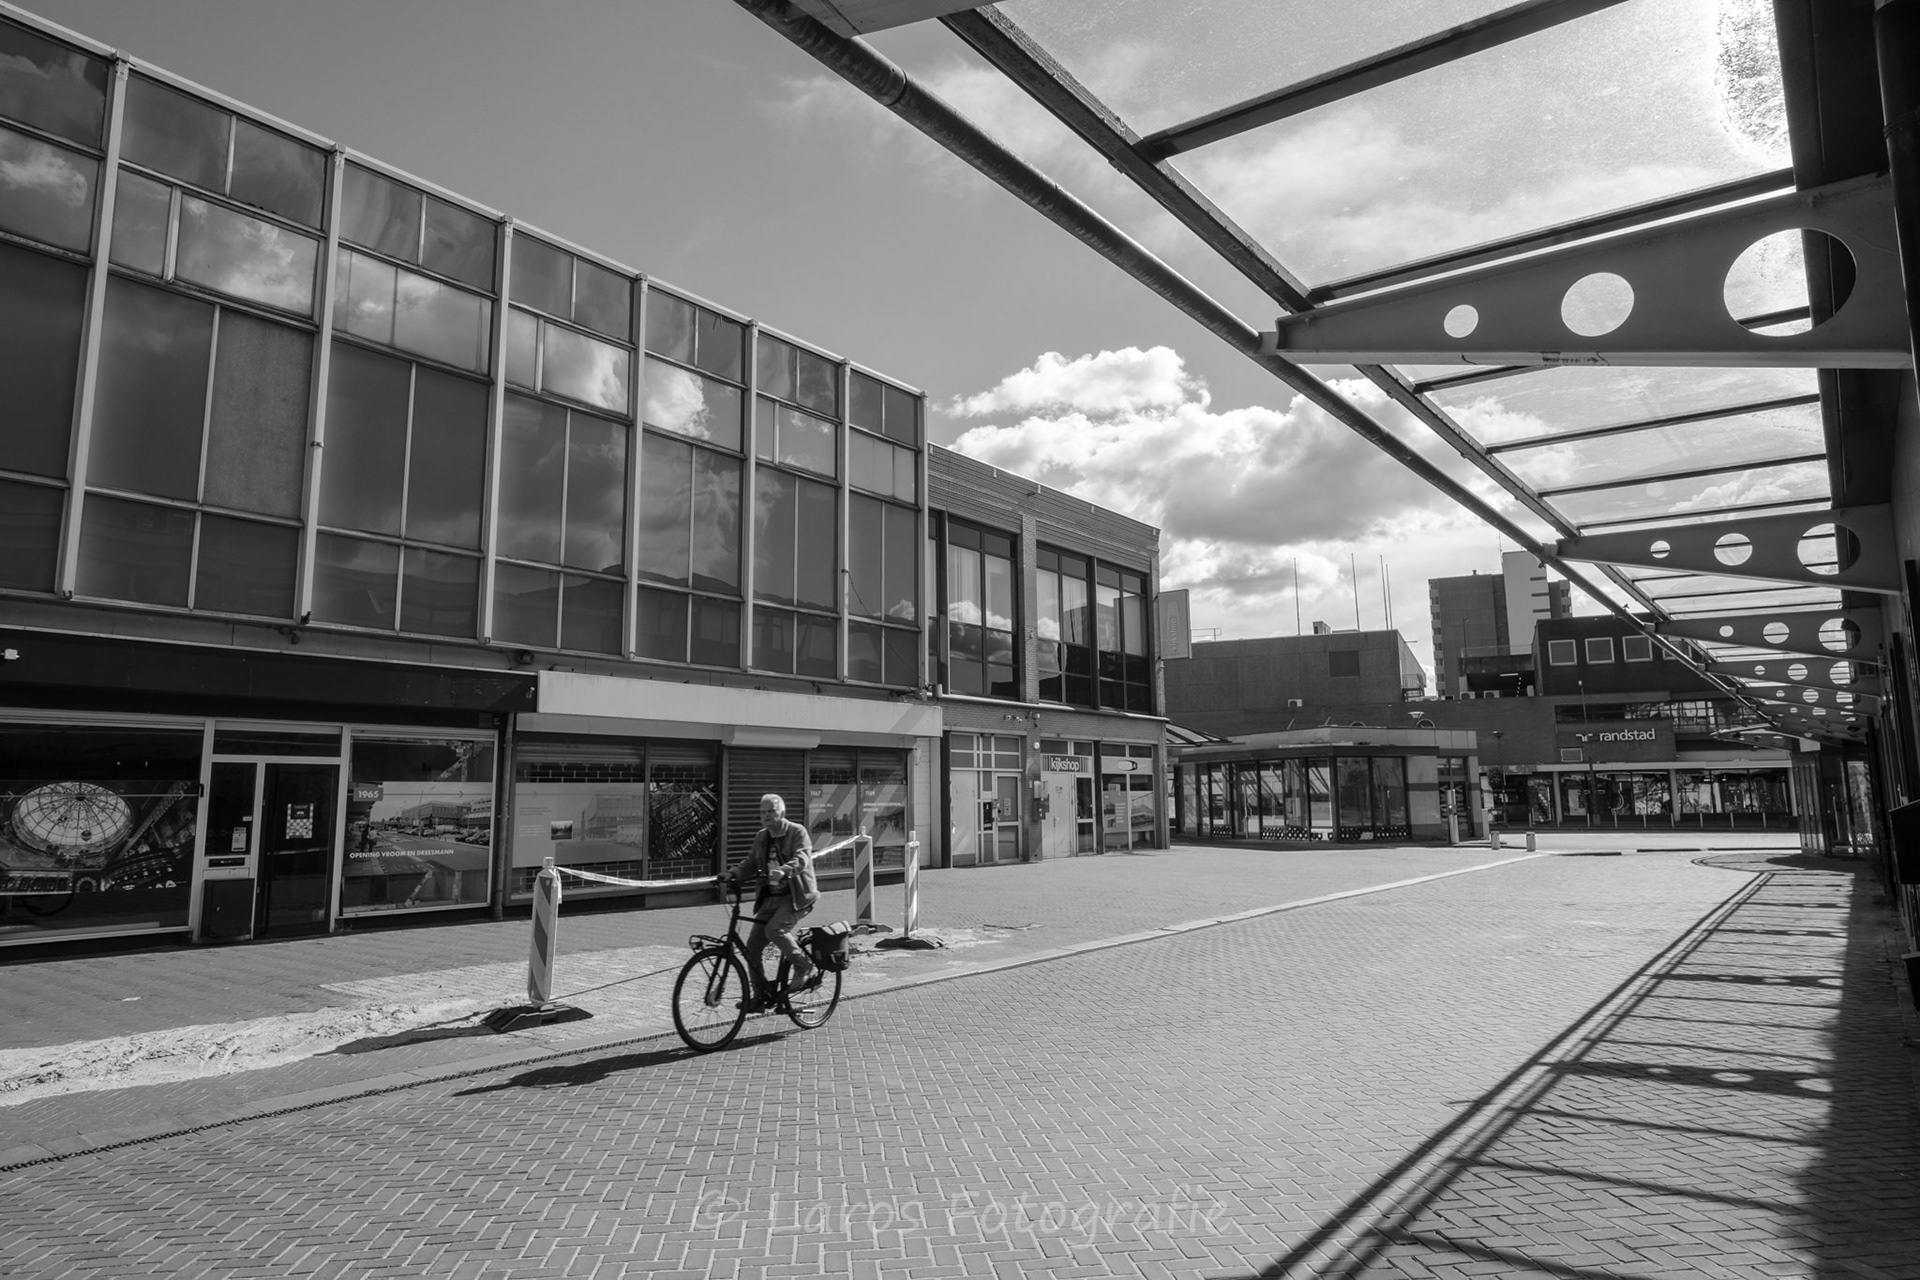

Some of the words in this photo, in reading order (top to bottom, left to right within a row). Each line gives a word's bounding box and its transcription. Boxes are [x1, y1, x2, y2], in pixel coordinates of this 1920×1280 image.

[1599, 728, 1656, 741] randstad
[1051, 757, 1079, 771] kijkshop
[358, 790, 379, 799] 1965
[349, 851, 380, 859] OPENING
